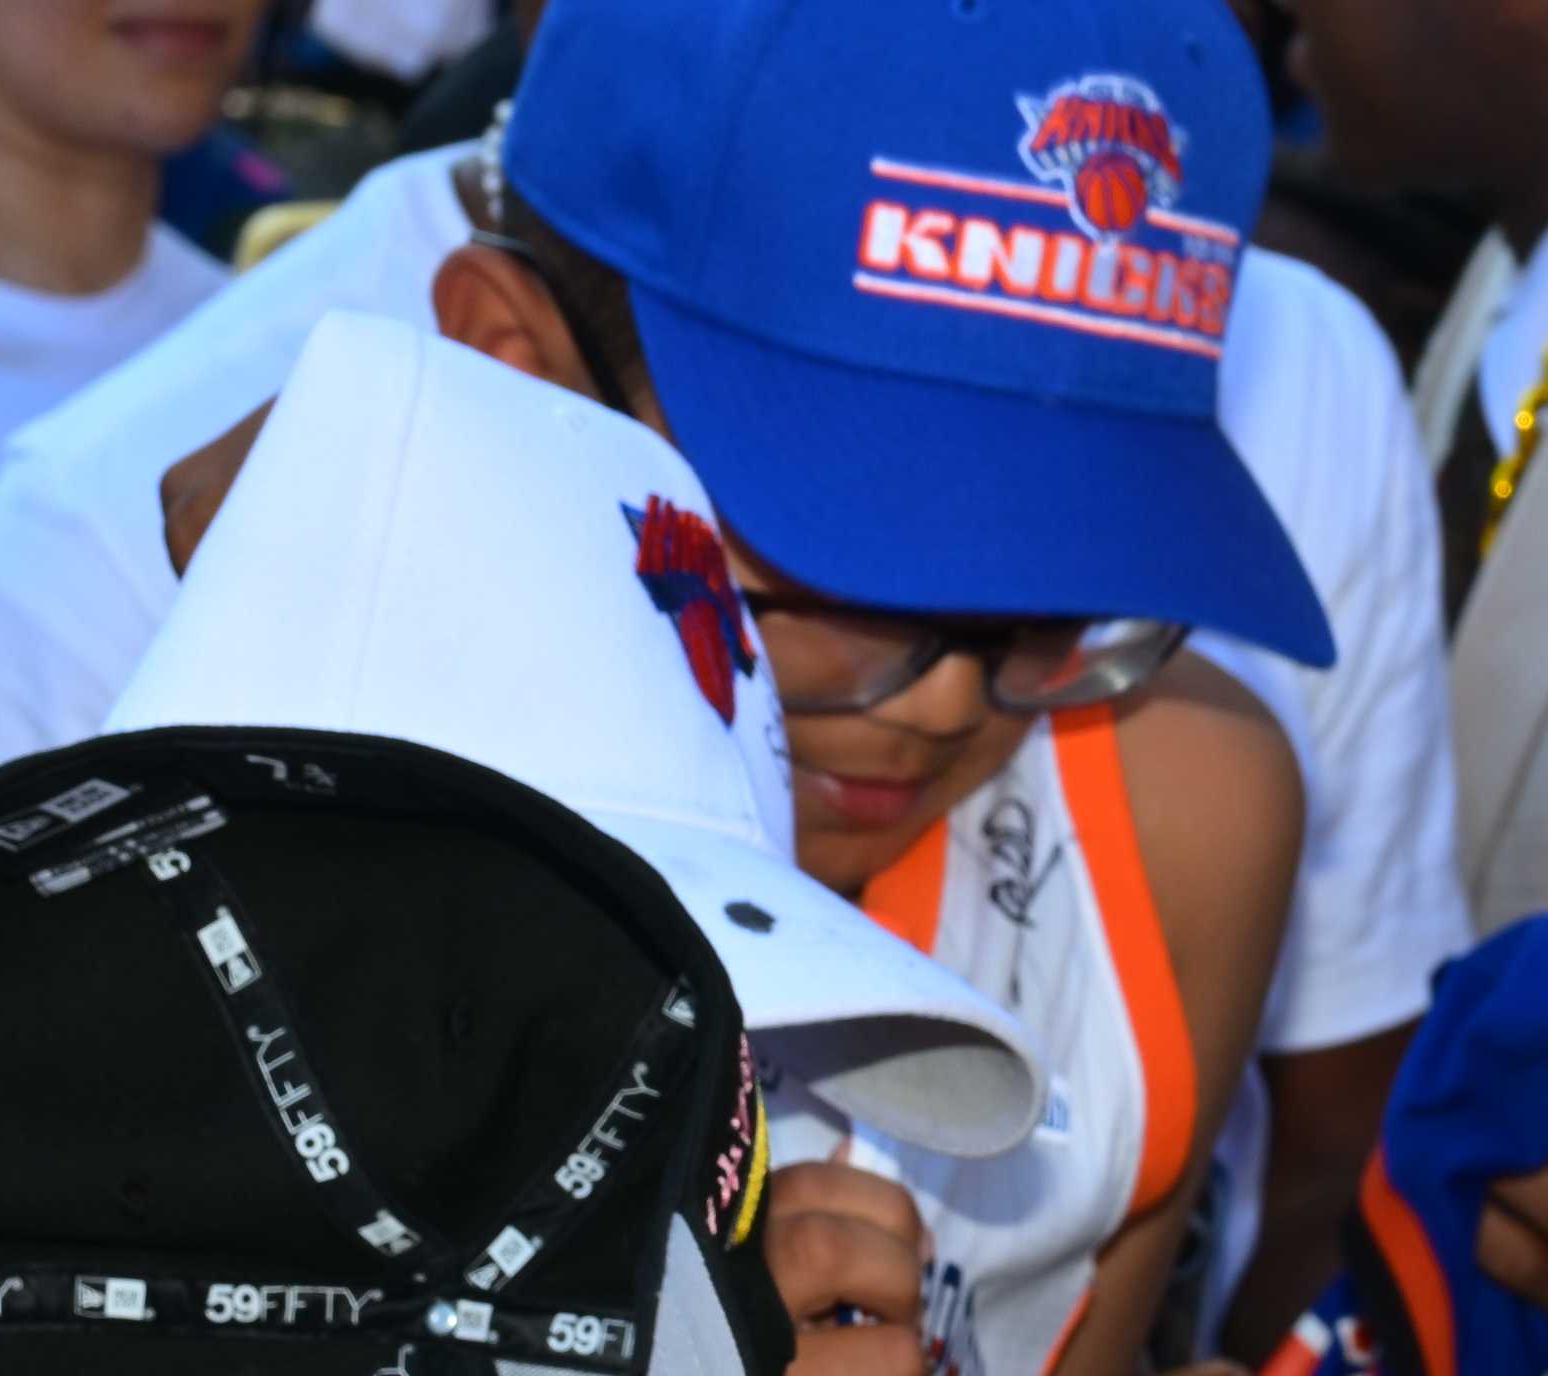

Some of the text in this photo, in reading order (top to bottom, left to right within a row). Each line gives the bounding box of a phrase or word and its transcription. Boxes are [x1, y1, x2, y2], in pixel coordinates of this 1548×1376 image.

[860, 199, 1230, 335] KNICKS
[205, 1283, 383, 1326] 59FIFTY
[546, 1312, 636, 1360] 59FI
